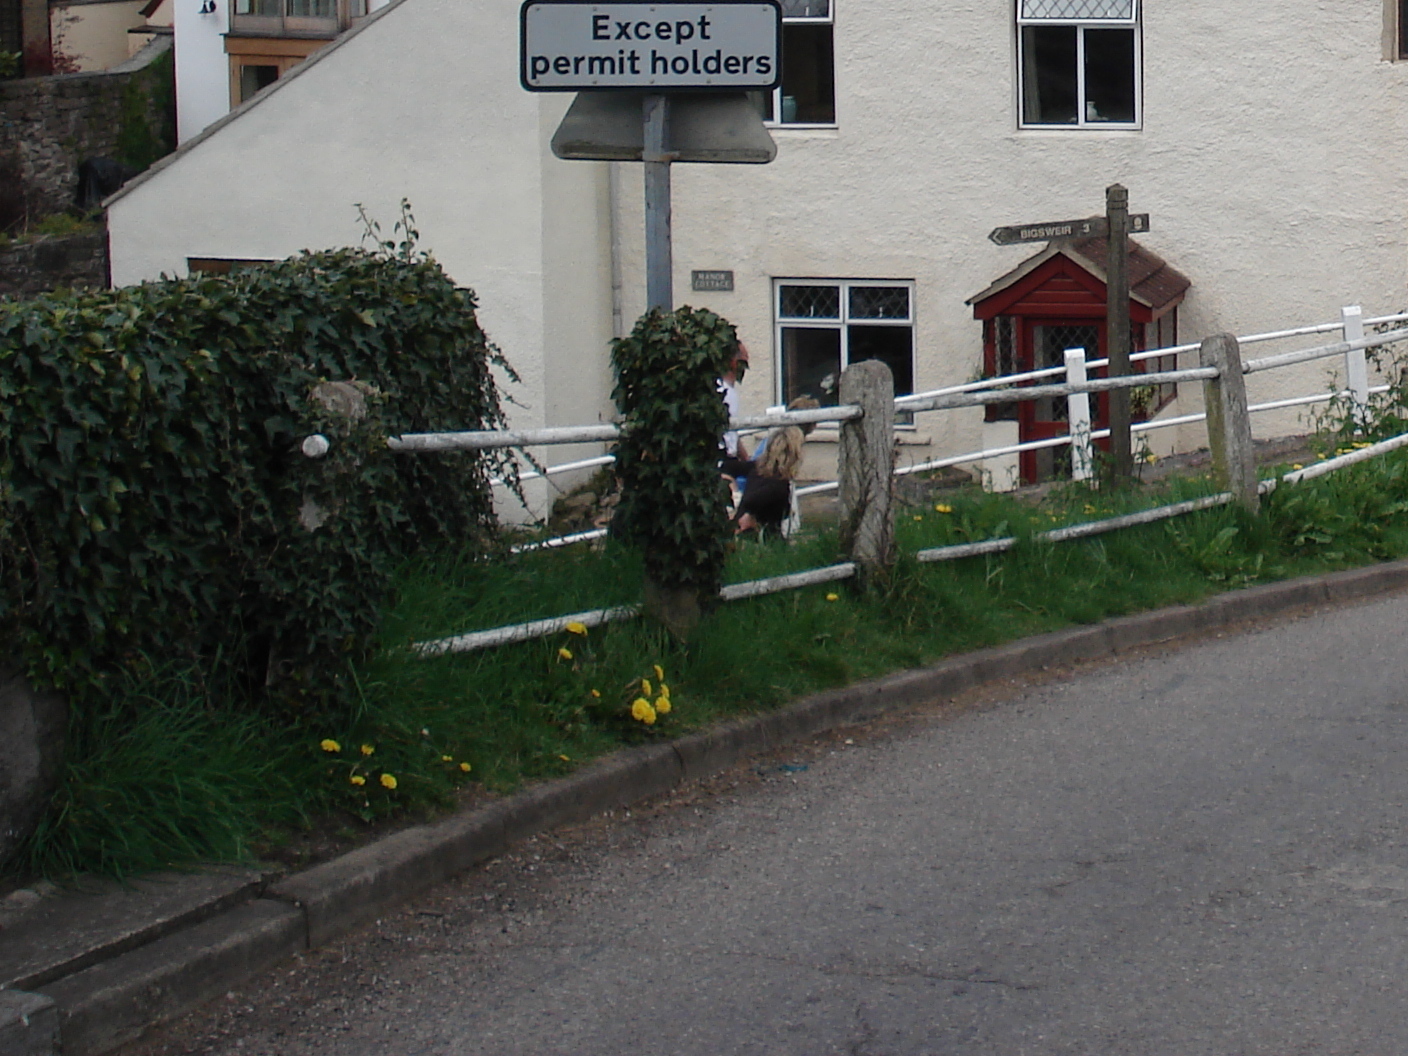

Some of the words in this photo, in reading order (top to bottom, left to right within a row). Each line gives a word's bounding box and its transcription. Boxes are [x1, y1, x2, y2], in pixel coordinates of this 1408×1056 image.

[592, 14, 712, 45] Except
[531, 49, 640, 80] permit
[651, 49, 772, 75] holders
[1020, 226, 1071, 239] BIGSWEIR
[1083, 223, 1090, 233] 3
